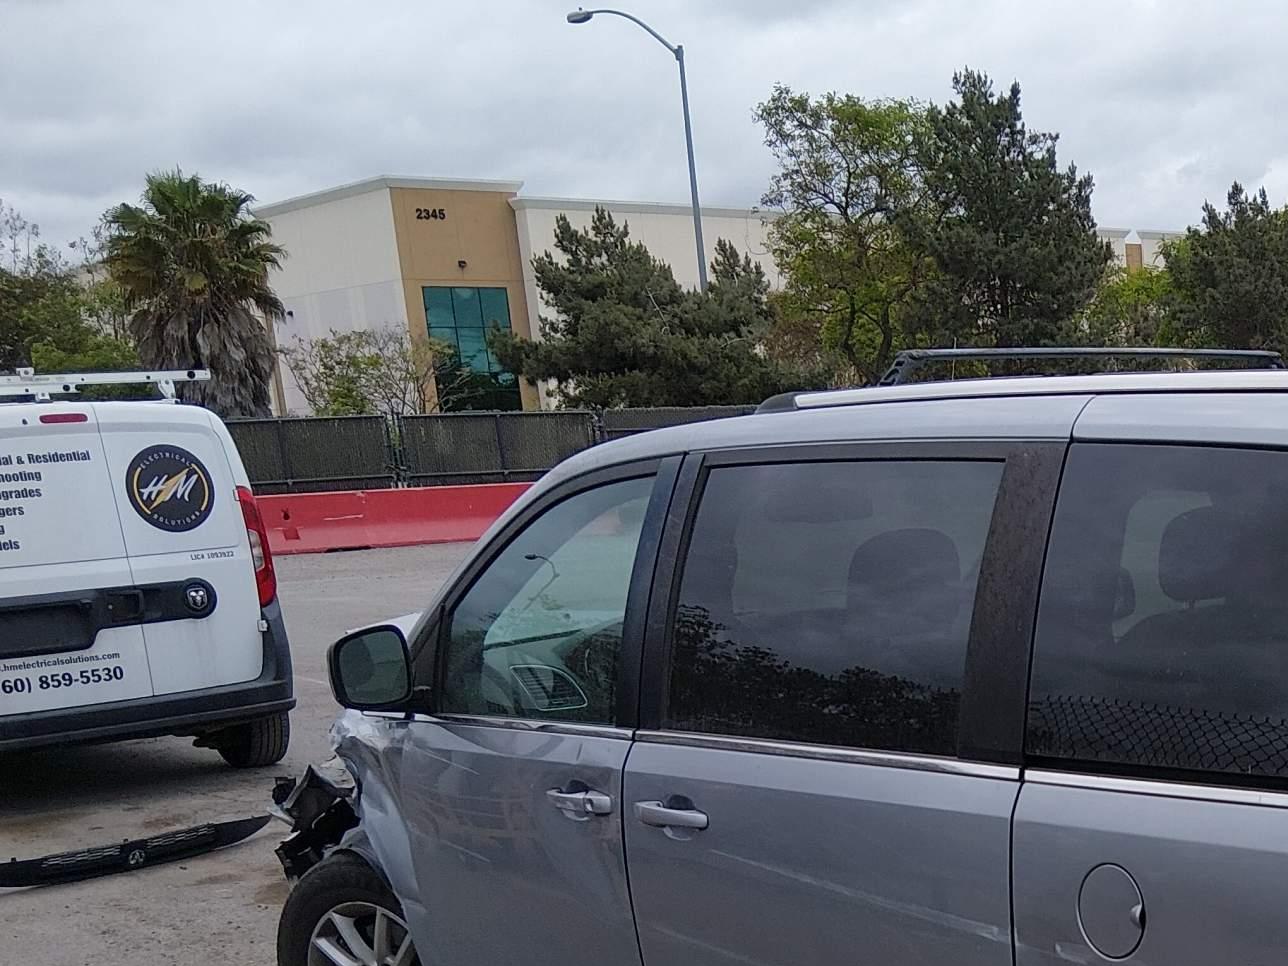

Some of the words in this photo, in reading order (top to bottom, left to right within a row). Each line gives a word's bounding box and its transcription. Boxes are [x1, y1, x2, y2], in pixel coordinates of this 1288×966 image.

[416, 208, 446, 220] 2345
[16, 455, 25, 465] &
[27, 450, 91, 464] Residential
[0, 487, 42, 501] grades
[0, 652, 120, 672] .hmelectricalsolutions.com
[38, 665, 124, 690] 859-5530
